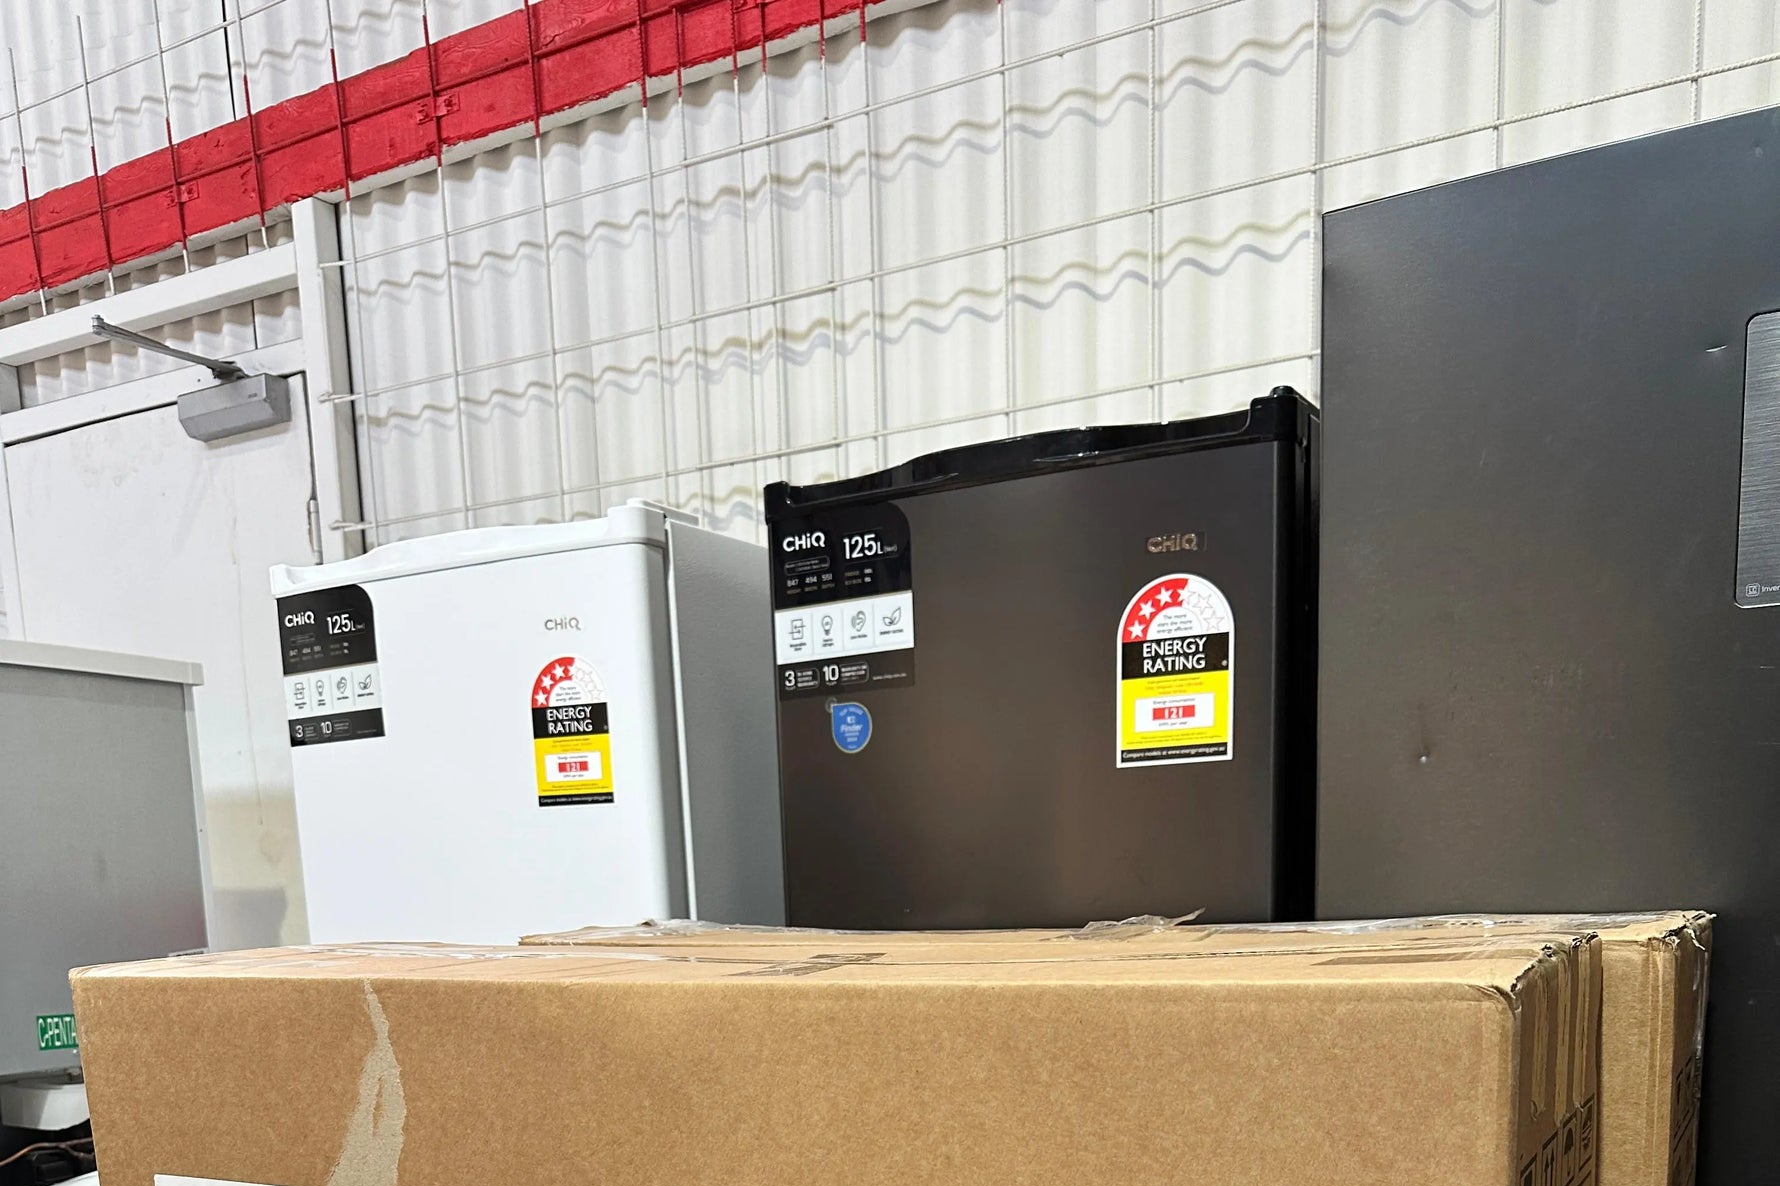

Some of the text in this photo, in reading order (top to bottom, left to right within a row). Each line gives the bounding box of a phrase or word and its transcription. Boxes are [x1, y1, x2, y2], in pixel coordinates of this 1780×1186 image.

[783, 532, 825, 552] CHiQ
[285, 611, 314, 627] CHiQ
[544, 617, 581, 630] CHiQ
[1142, 637, 1206, 658] ENERGY
[1144, 654, 1206, 674] RATING
[785, 670, 795, 687] 3
[822, 664, 839, 682] 10
[547, 706, 592, 721] ENERGY
[1164, 707, 1184, 719] 121
[295, 725, 303, 738] 3
[321, 721, 332, 734] 10
[548, 719, 592, 734] RATING
